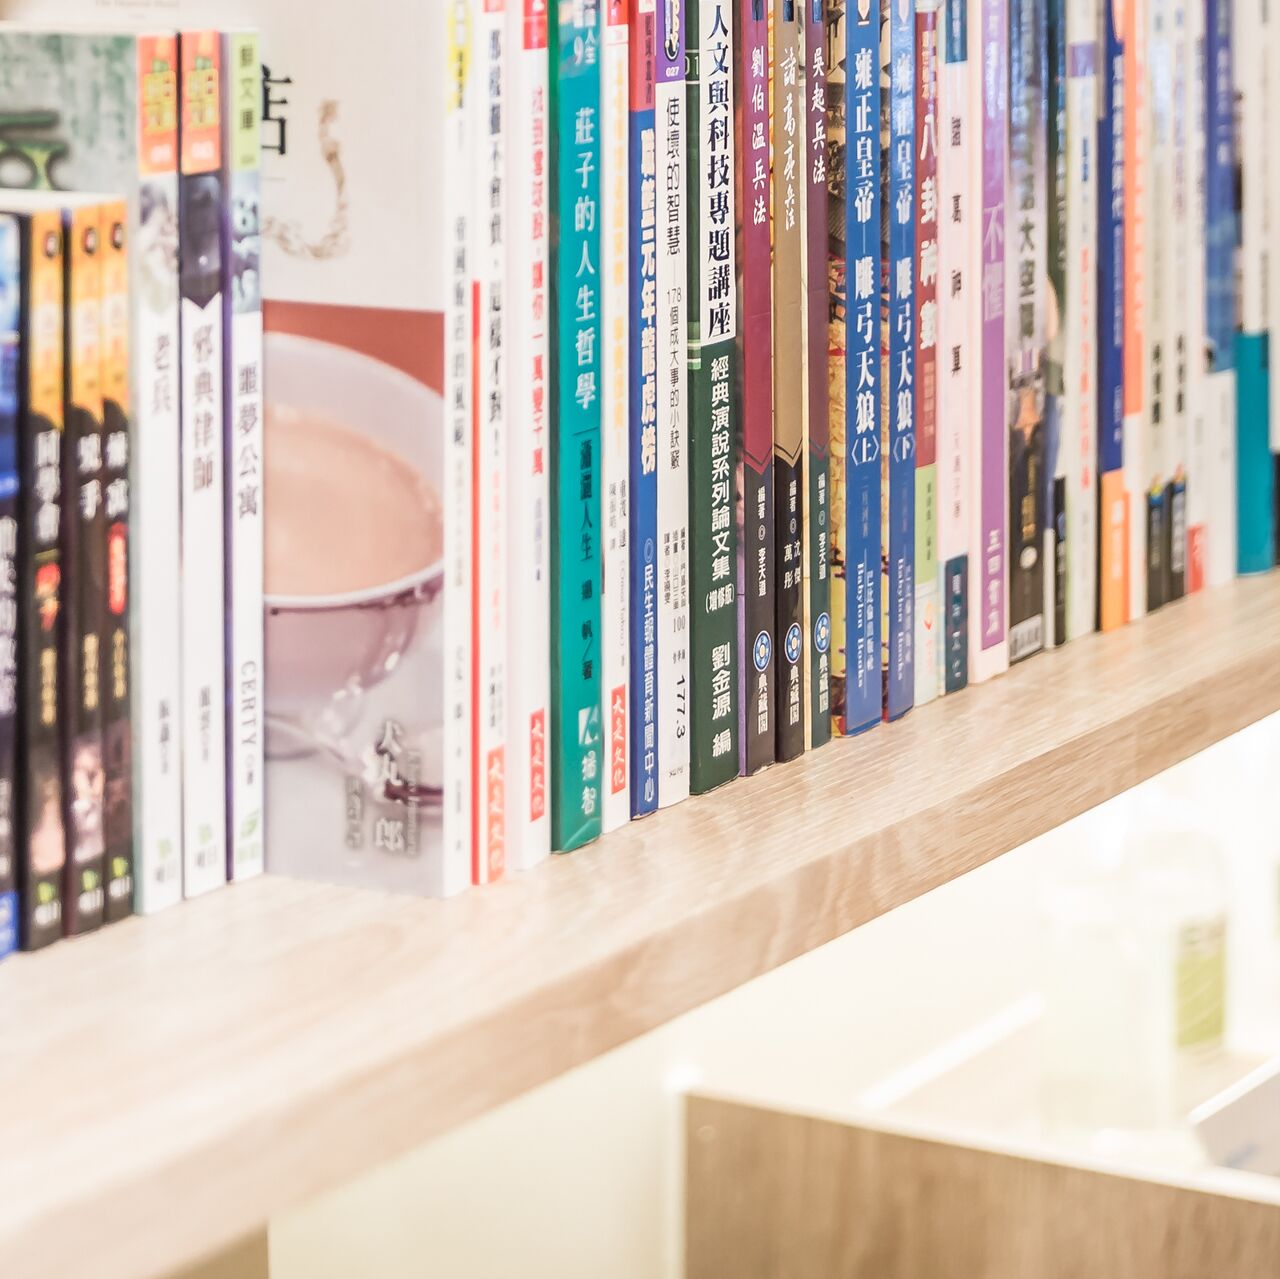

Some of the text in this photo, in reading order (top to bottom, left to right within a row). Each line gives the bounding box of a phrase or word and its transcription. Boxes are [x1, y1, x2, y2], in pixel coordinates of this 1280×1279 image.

[665, 66, 680, 77] 027
[750, 45, 767, 226] 劉伯溫兵法
[779, 47, 797, 231] 諸葛亮兵法
[811, 46, 827, 185] 吳起兵法
[854, 47, 875, 224] 雍正皇帝
[666, 96, 681, 255] 使壞的智慧
[574, 108, 596, 410] 莊子的人生哲學
[705, 4, 735, 614] 人文與科技專題講座 經典演說系列論文集 (增修版)
[237, 364, 261, 519] 噩夢公寓
[757, 547, 767, 597] 李天道
[237, 660, 257, 746] CERTY
[612, 690, 626, 788] 大是文化
[711, 642, 732, 758] 劉金源 編
